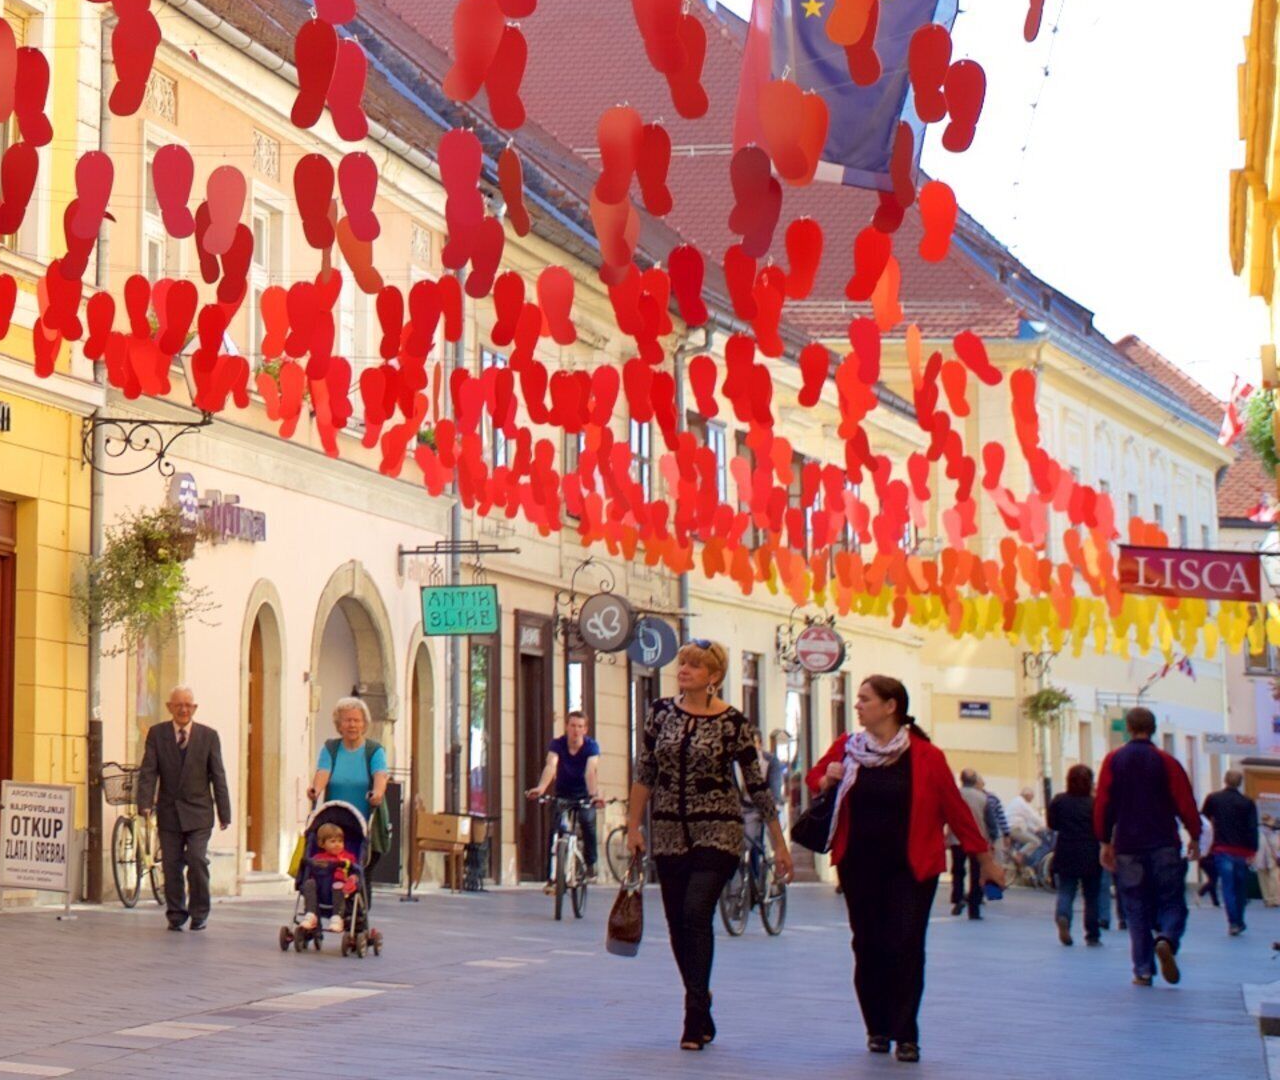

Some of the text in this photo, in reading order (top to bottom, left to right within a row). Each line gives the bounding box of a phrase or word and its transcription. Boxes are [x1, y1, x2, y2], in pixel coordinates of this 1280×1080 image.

[1134, 556, 1256, 595] LISCA
[428, 591, 490, 607] ANTIK
[11, 815, 64, 839] OTKUP
[5, 839, 28, 861] ZLATA
[35, 841, 66, 864] SREBRA
